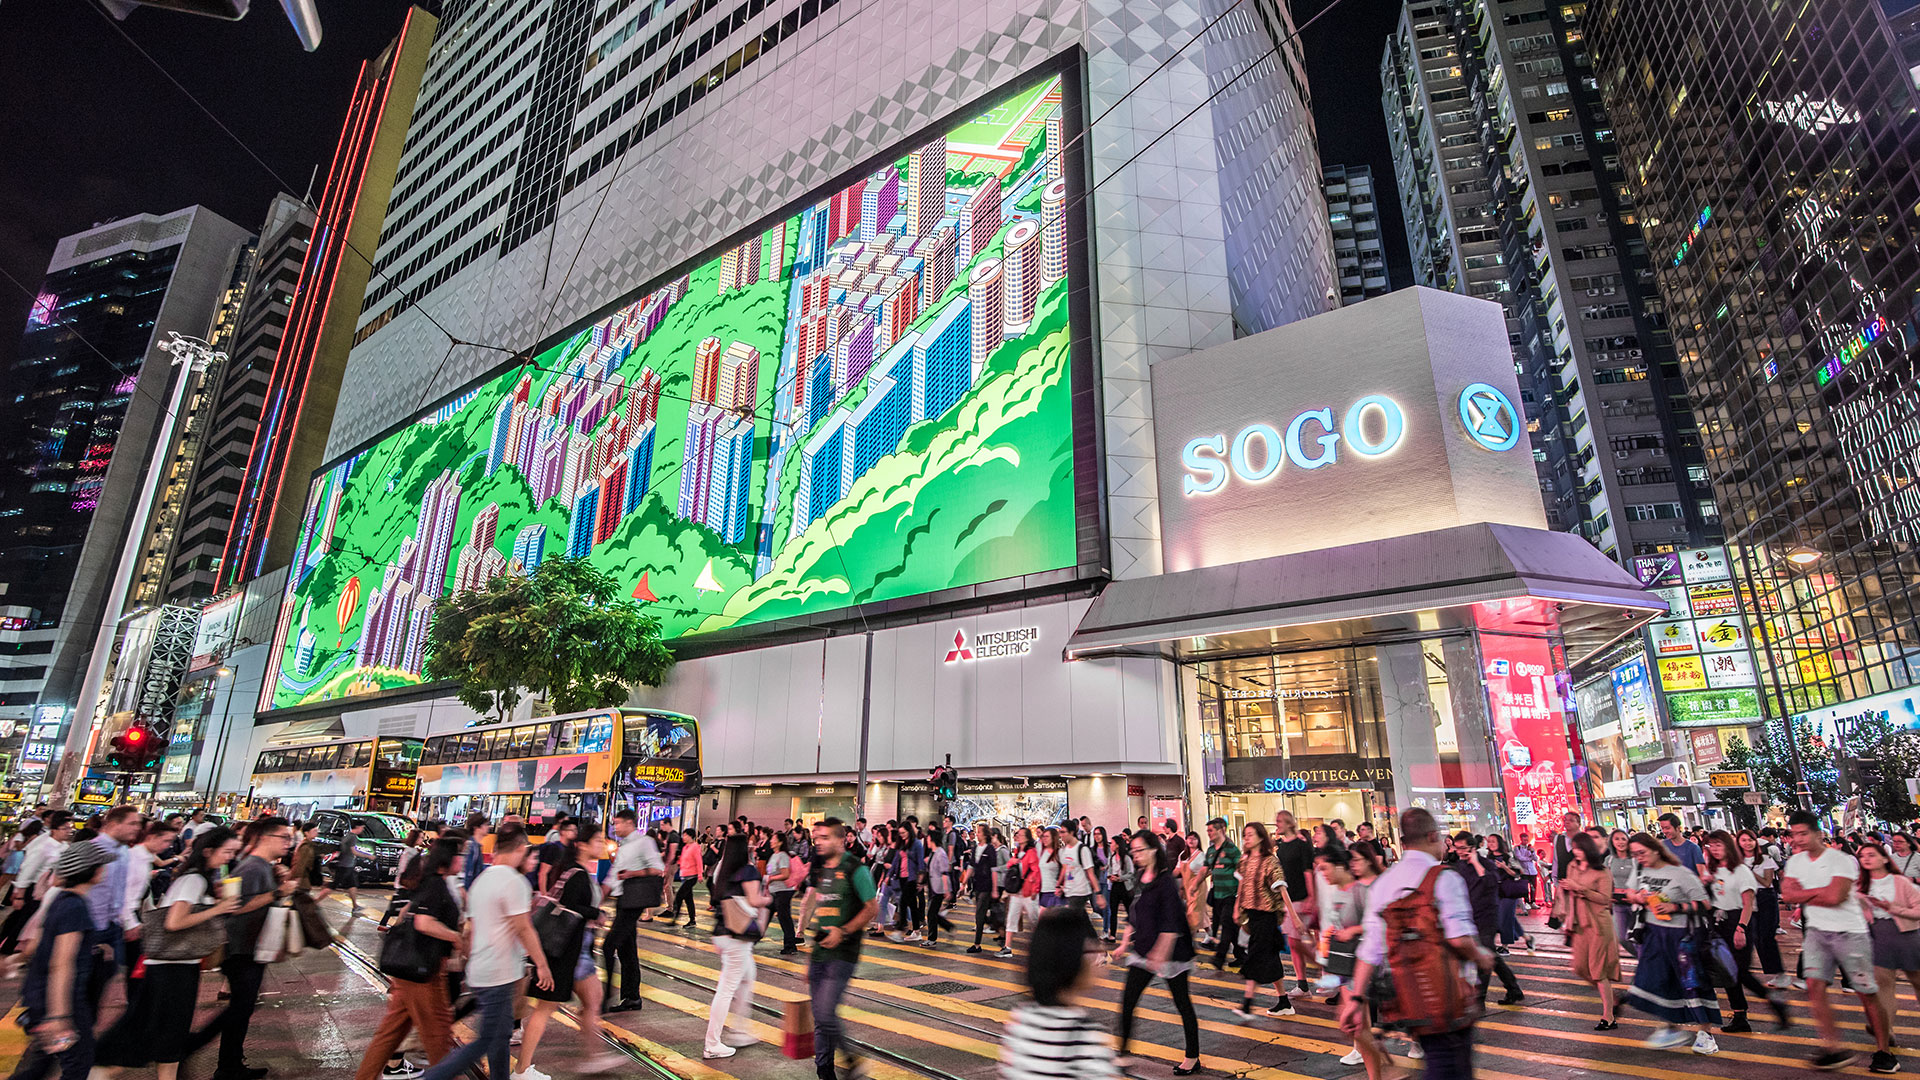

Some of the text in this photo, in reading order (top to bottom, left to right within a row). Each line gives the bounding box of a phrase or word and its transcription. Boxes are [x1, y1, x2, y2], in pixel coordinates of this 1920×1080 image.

[1182, 394, 1403, 494] SOGO
[1636, 558, 1655, 568] THAI
[976, 628, 1037, 646] MITSUBISHI
[976, 641, 1029, 658] ELECTRIC
[1711, 655, 1736, 673] 潮
[664, 768, 684, 782] 962B
[1289, 769, 1360, 782] BOTTEGA
[1264, 778, 1306, 792] SOGO
